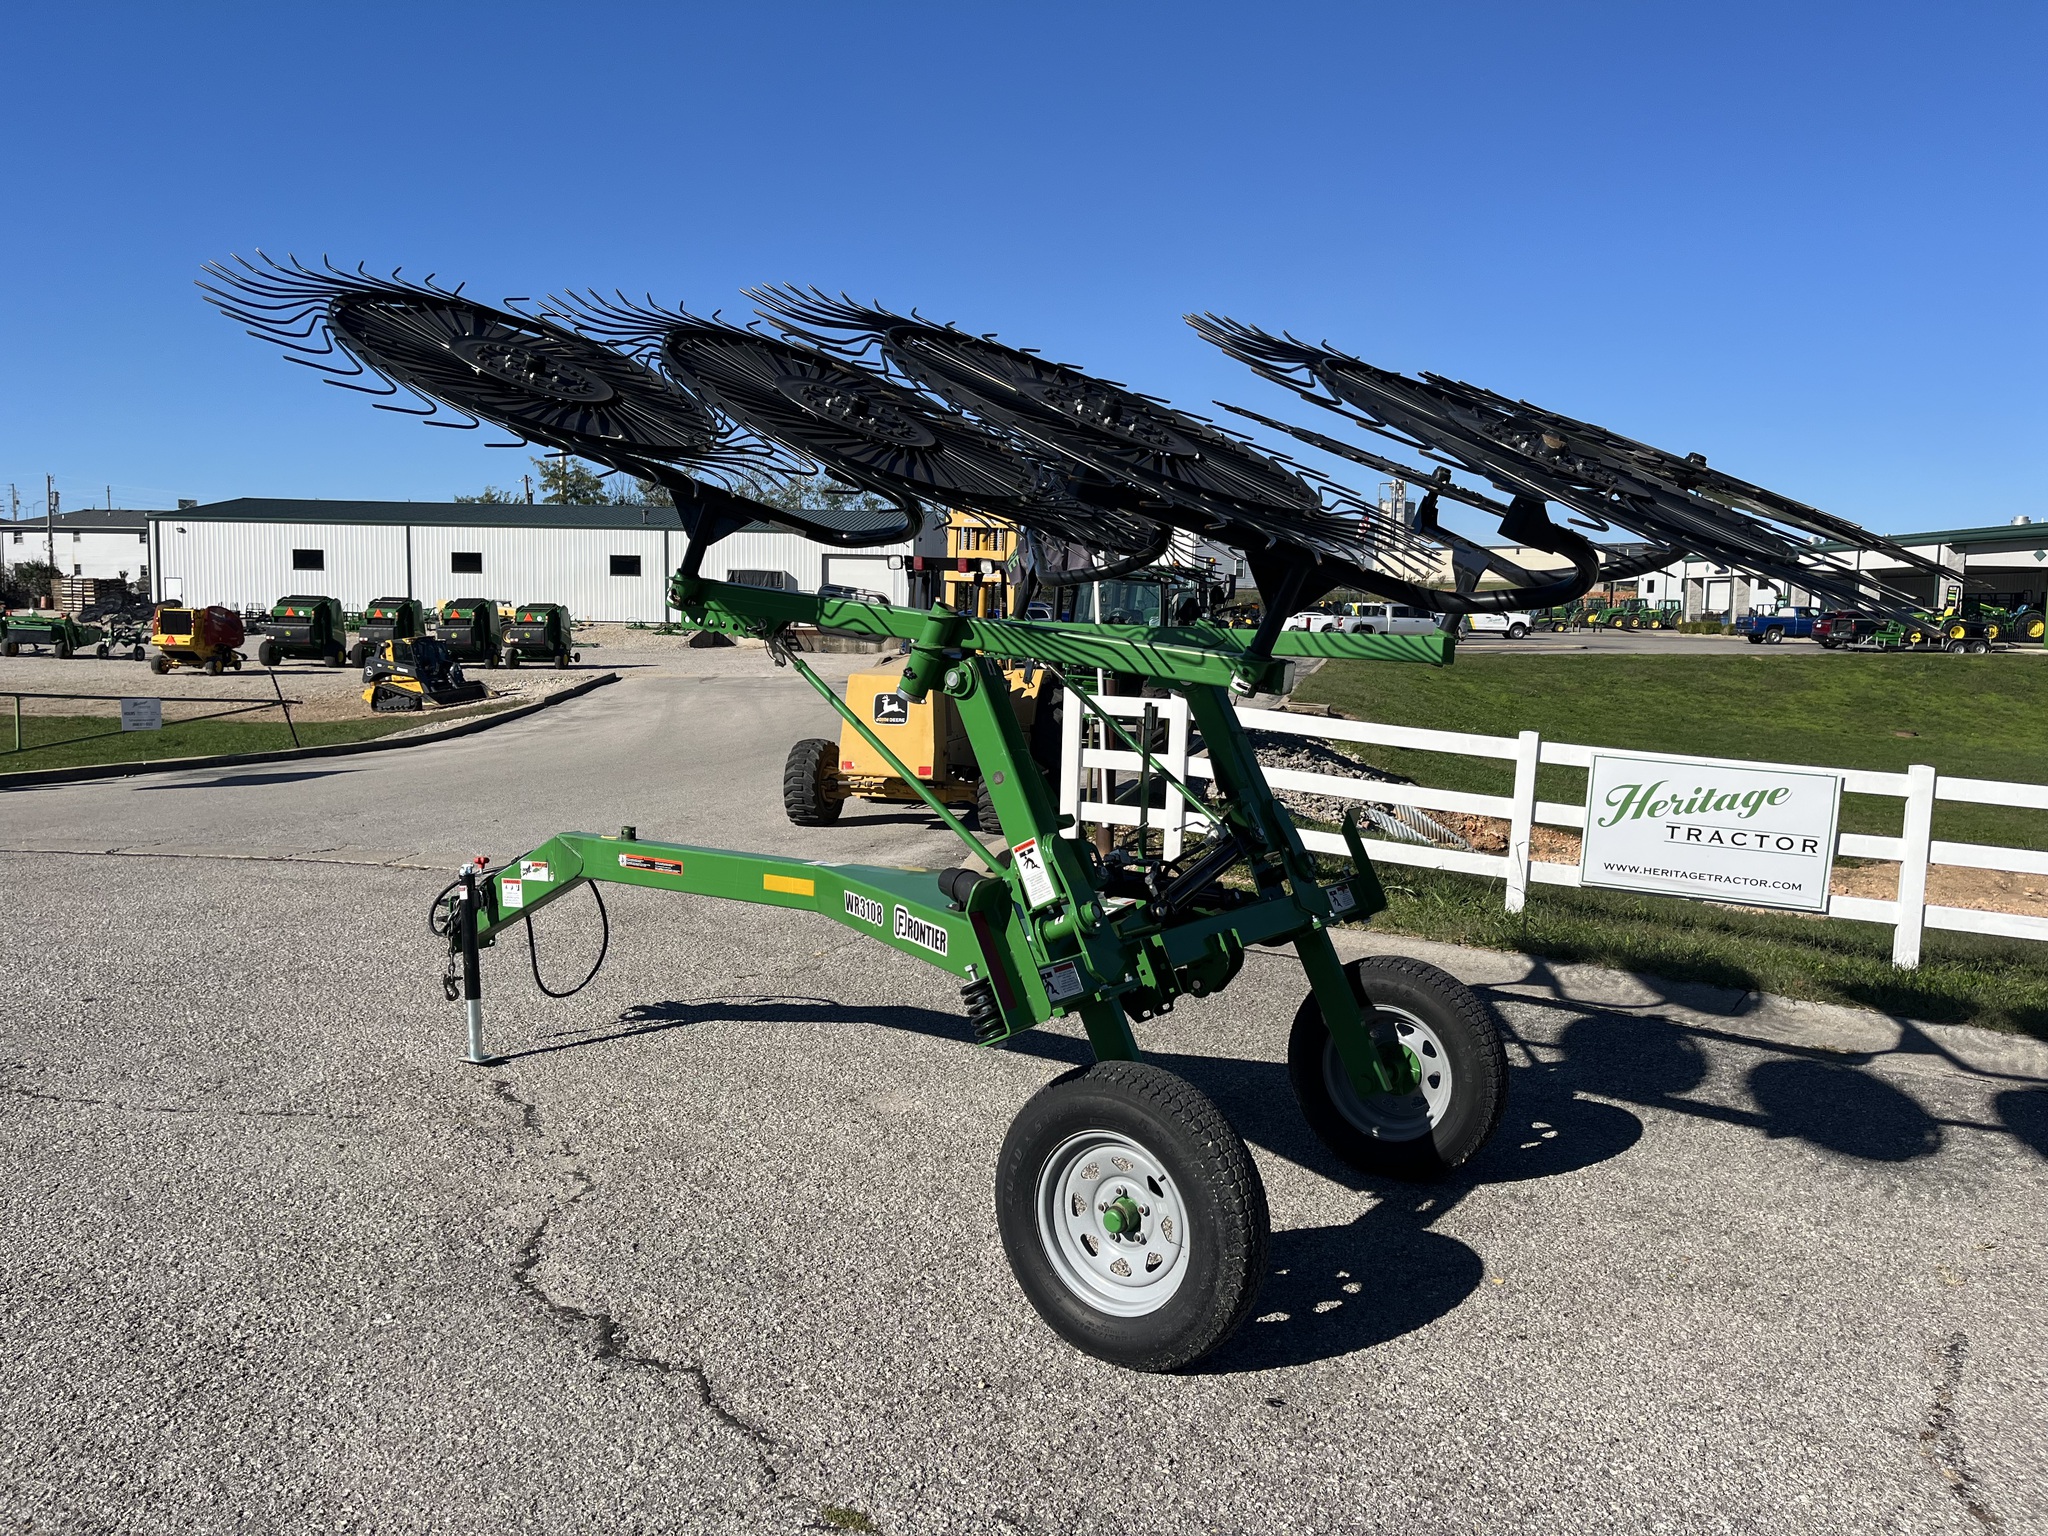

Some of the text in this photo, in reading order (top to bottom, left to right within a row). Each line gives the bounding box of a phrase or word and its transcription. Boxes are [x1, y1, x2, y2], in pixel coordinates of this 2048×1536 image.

[1597, 779, 1793, 828] Heritage
[1665, 825, 1819, 854] TRACTOR
[1603, 861, 1802, 892] WWW.HERITAGETRACTOR.COM
[845, 892, 946, 953] WR3108 FRONTIER
